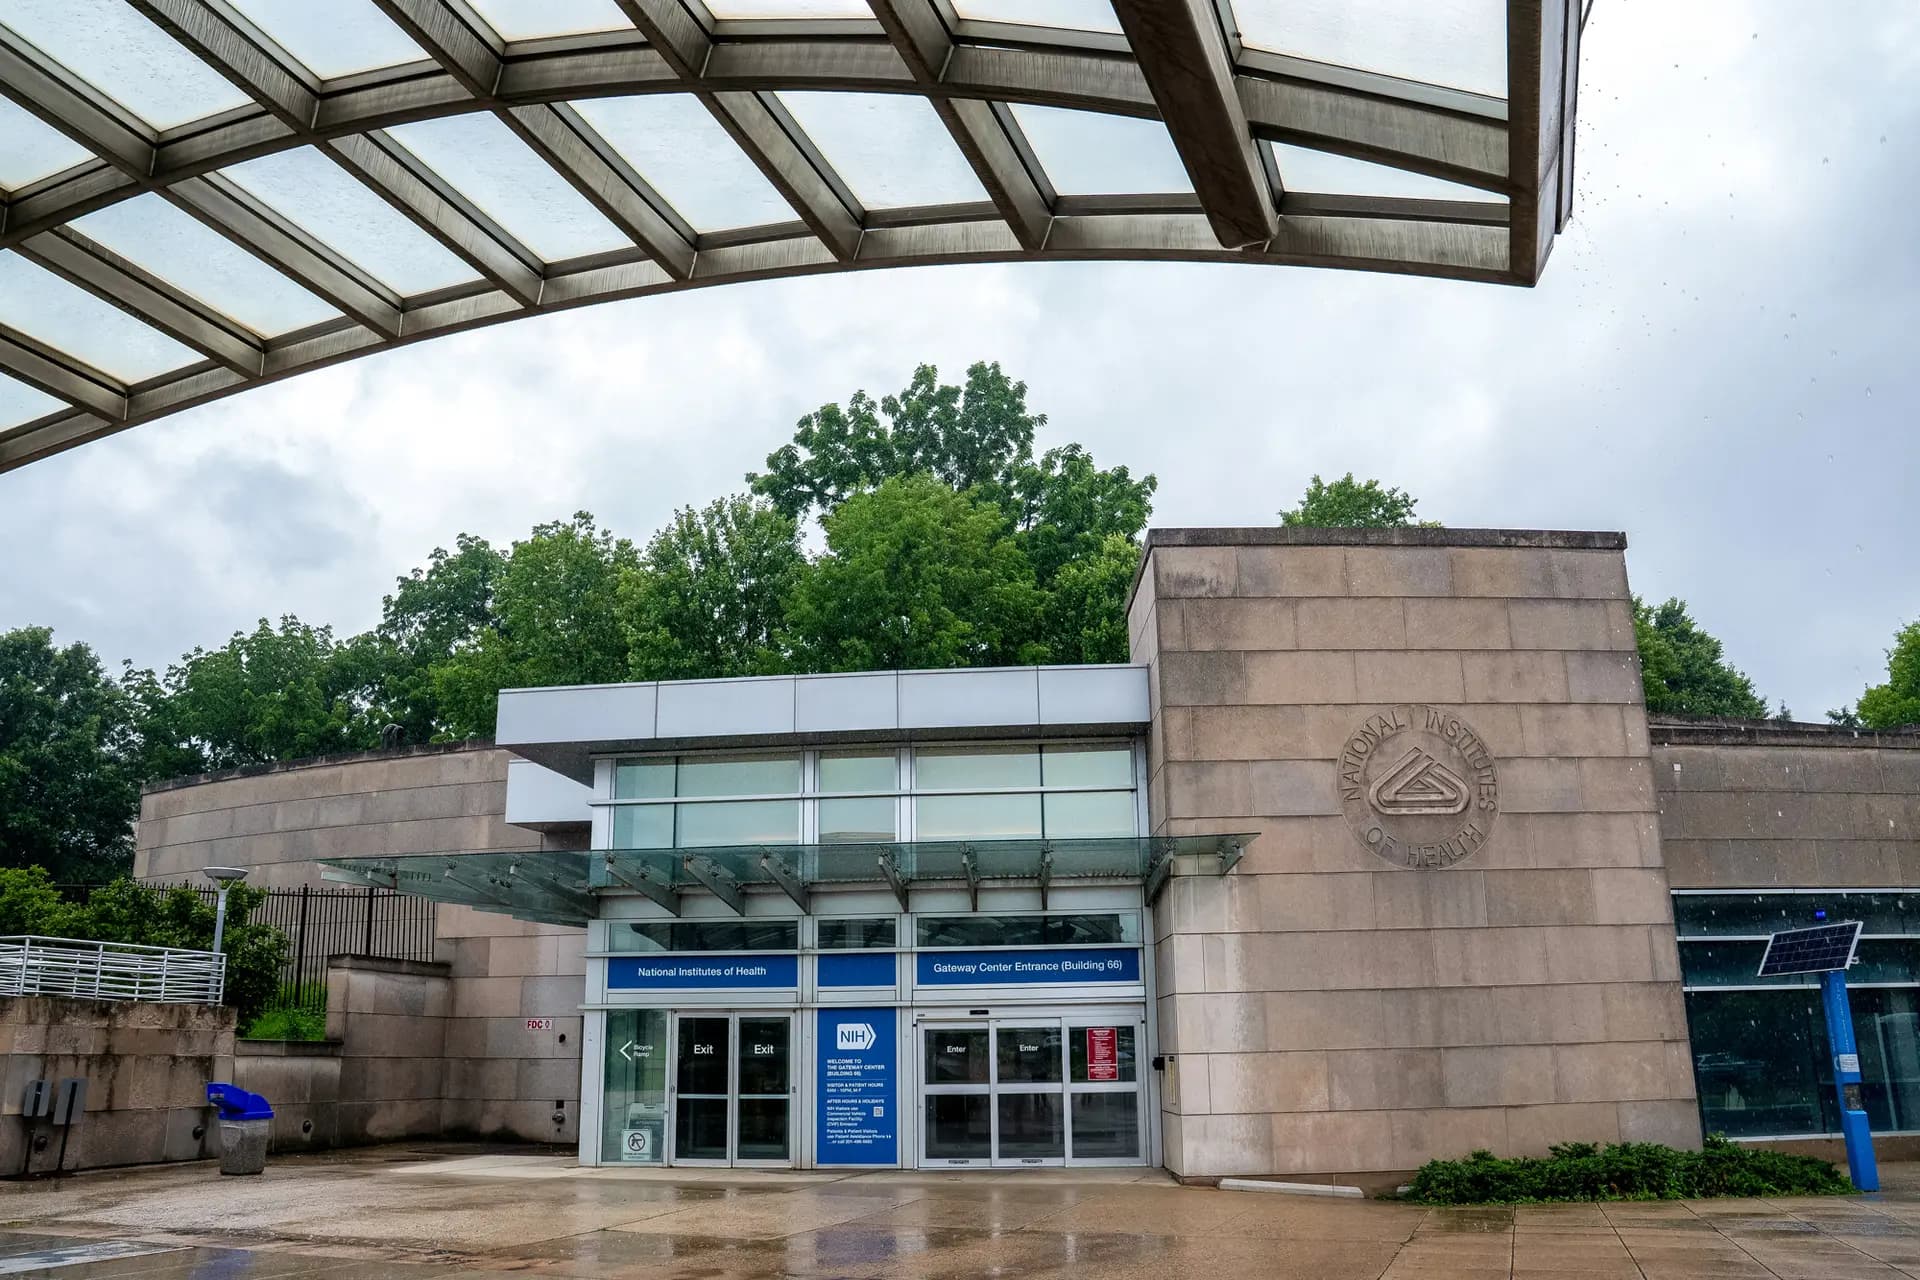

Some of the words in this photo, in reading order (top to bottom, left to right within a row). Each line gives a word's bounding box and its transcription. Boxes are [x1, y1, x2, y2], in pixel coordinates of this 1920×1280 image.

[1341, 710, 1405, 802] NATIONAL
[1425, 709, 1498, 812] INSTITUTES
[1366, 827, 1397, 854] OF
[1407, 823, 1484, 867] HEALTH
[638, 967, 677, 977] National
[679, 966, 722, 976] Institutes
[724, 966, 734, 976] of
[736, 966, 767, 976] Health
[933, 962, 976, 974] Gateway
[979, 962, 1012, 973] Center
[1015, 961, 1059, 972] Entrance
[1061, 960, 1105, 972] (Building
[1107, 959, 1122, 970] 66)
[527, 1020, 543, 1029] FDC
[840, 1030, 865, 1043] NIH
[693, 1044, 713, 1054] Exit
[754, 1044, 774, 1054] Exit
[946, 1045, 966, 1053] Enter
[1019, 1044, 1039, 1053] Enter
